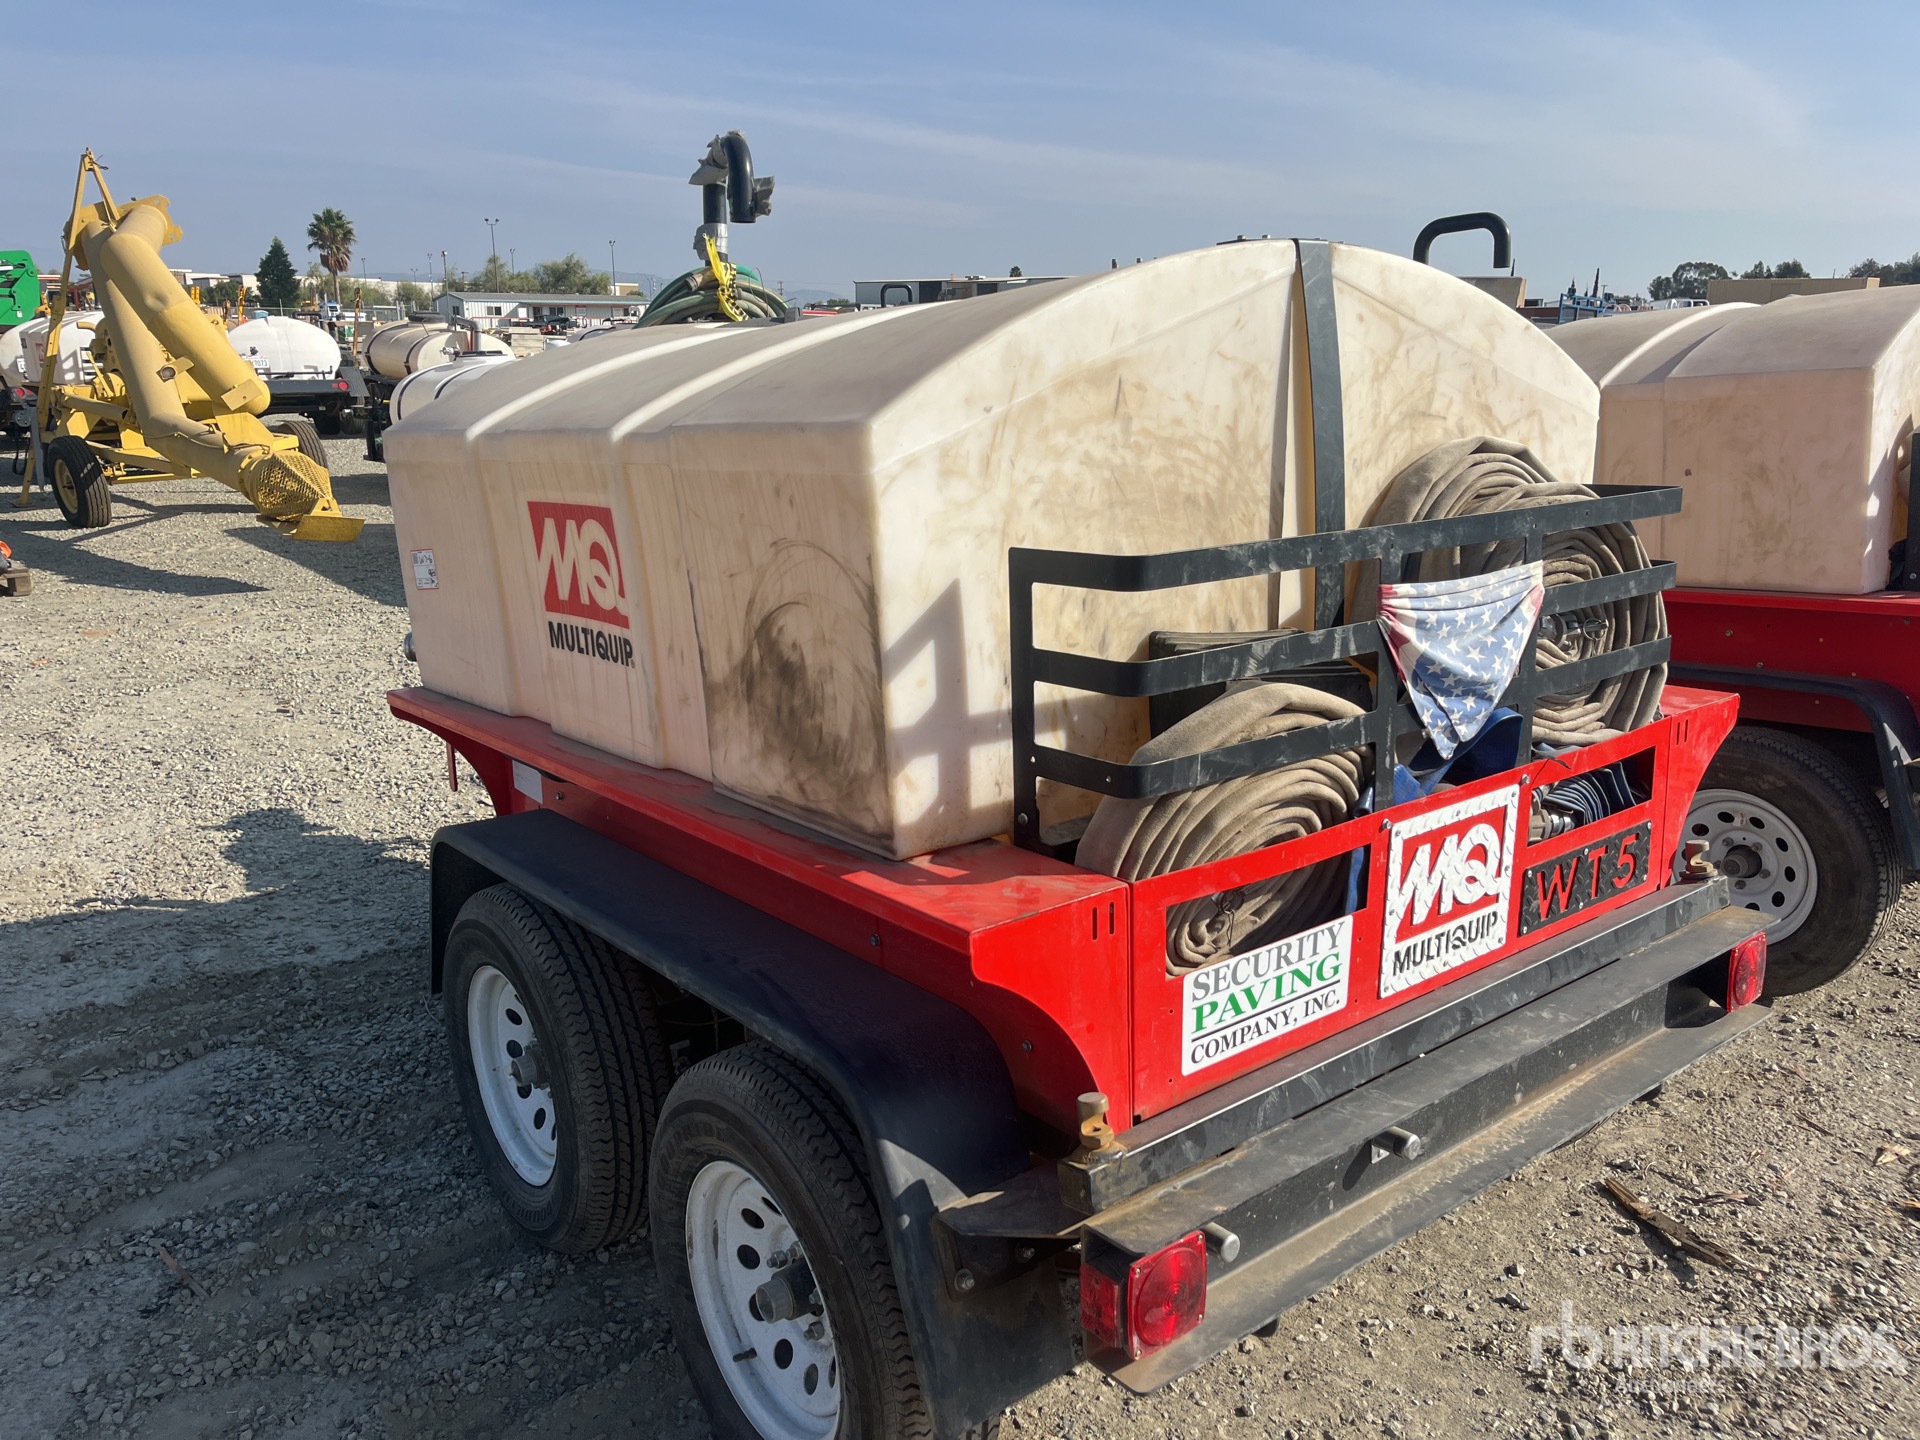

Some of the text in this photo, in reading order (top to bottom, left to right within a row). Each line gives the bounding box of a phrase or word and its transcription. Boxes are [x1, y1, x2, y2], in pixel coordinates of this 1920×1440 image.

[538, 516, 631, 616] MQ
[548, 621, 634, 668] MULTIQUIP
[1398, 822, 1504, 926] MQ
[1191, 921, 1346, 1001] SECURITY
[1392, 909, 1499, 977] MULTIQUIP
[1190, 951, 1343, 1034] PAVING
[1190, 988, 1341, 1065] COMPANY, INC.
